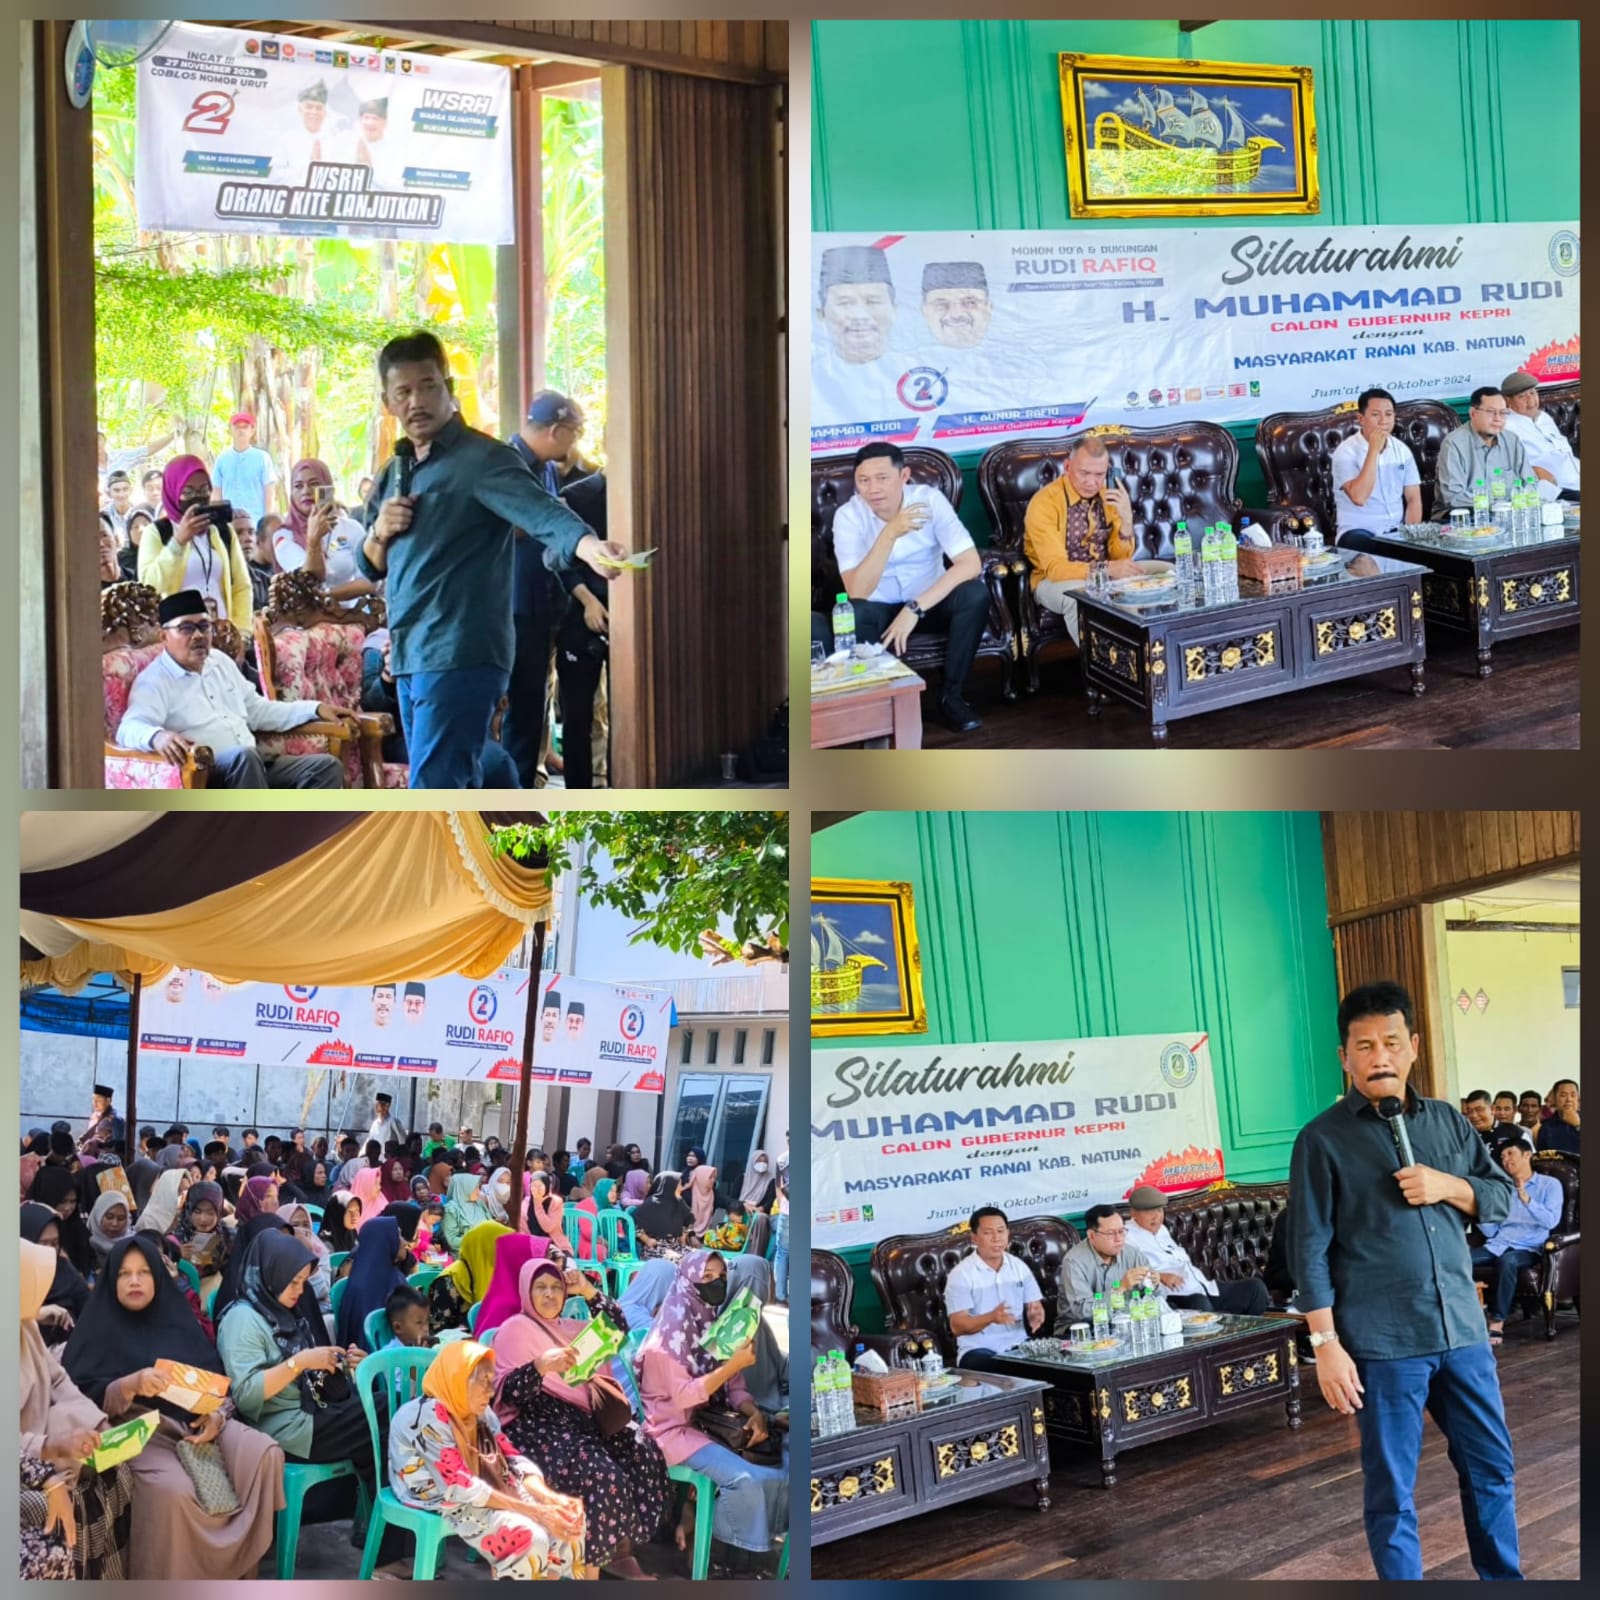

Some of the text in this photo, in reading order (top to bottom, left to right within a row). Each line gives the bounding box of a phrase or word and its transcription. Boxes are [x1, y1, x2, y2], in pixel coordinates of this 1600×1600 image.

[165, 59, 256, 76] 27 NOVEMBER 2024
[187, 51, 222, 62] INGAT
[151, 68, 268, 88] COBLOS NOMOR URUT
[182, 90, 235, 134] 2
[423, 88, 492, 115] WSRH
[309, 165, 365, 192] WSRH
[220, 186, 287, 214] ORANG
[289, 191, 331, 216] KITE
[333, 192, 428, 221] LANJUTKAN
[1012, 247, 1054, 256] MOHON
[1101, 244, 1158, 254] DUKUNGAN
[1222, 235, 1464, 285] Silaturahmi
[1015, 257, 1157, 275] RUDI RAFIQ
[1121, 281, 1563, 324] H. MUHAMMAD RUDI
[1270, 308, 1511, 333] CALON GUBERNUR KEPRI
[1352, 327, 1424, 340] dengan
[1234, 335, 1526, 369] MASYARAKAT RANAI KAB. NATUNA
[913, 377, 932, 401] 2
[1386, 378, 1441, 391] Oktober
[1443, 374, 1472, 385] 2024
[871, 422, 901, 432] RUDI
[980, 409, 1021, 422] AUNUR
[256, 1002, 293, 1021] RUDI
[296, 1007, 341, 1028] RAFIQ
[477, 994, 488, 1015] 2
[627, 1012, 637, 1032] 2
[446, 1024, 475, 1040] RUDI
[478, 1028, 514, 1047] RAFIQ
[600, 1040, 626, 1054] RUDI
[627, 1043, 657, 1060] RAFIQ
[826, 1051, 1075, 1109] Silaturahmi
[1094, 1092, 1177, 1117] RUDI
[881, 1121, 1126, 1155] CALON GUBERNUR KEPRI
[966, 1146, 1039, 1160] dengan
[844, 1147, 1142, 1194] MASYARAKAT RANAI KAB. NATUNA
[1004, 1194, 1058, 1209] Oktober
[1060, 1189, 1089, 1201] 2024
